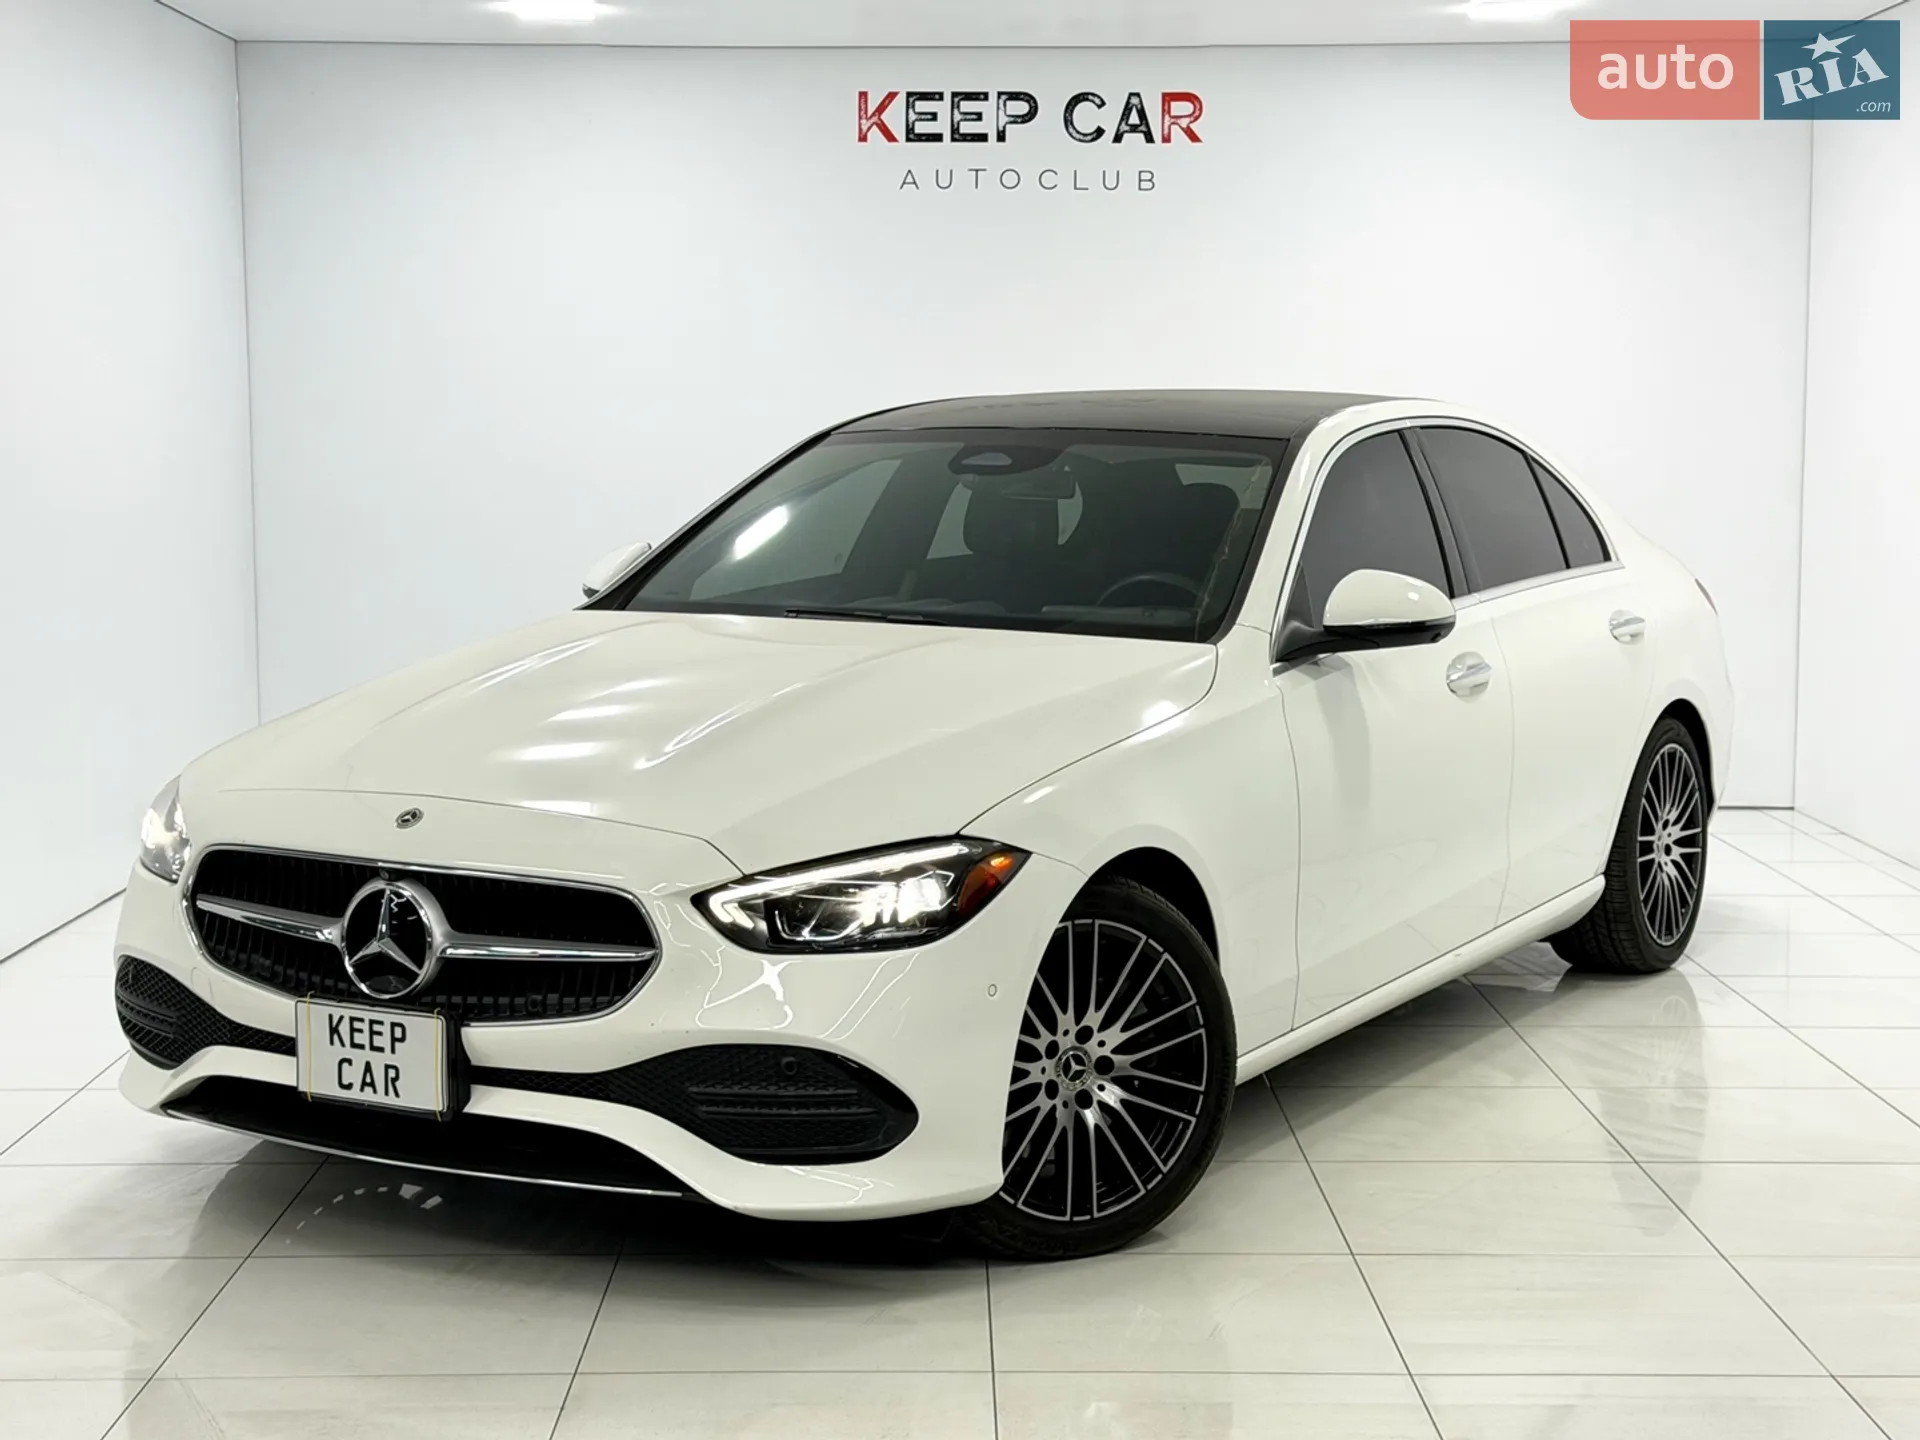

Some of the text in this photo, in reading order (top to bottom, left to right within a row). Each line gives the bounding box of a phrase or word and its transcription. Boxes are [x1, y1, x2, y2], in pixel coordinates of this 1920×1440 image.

[857, 90, 1205, 144] KEEP CAR
[899, 168, 1157, 192] AUTOCLUB
[328, 1012, 407, 1055] KEEP
[337, 1057, 401, 1098] CAR
